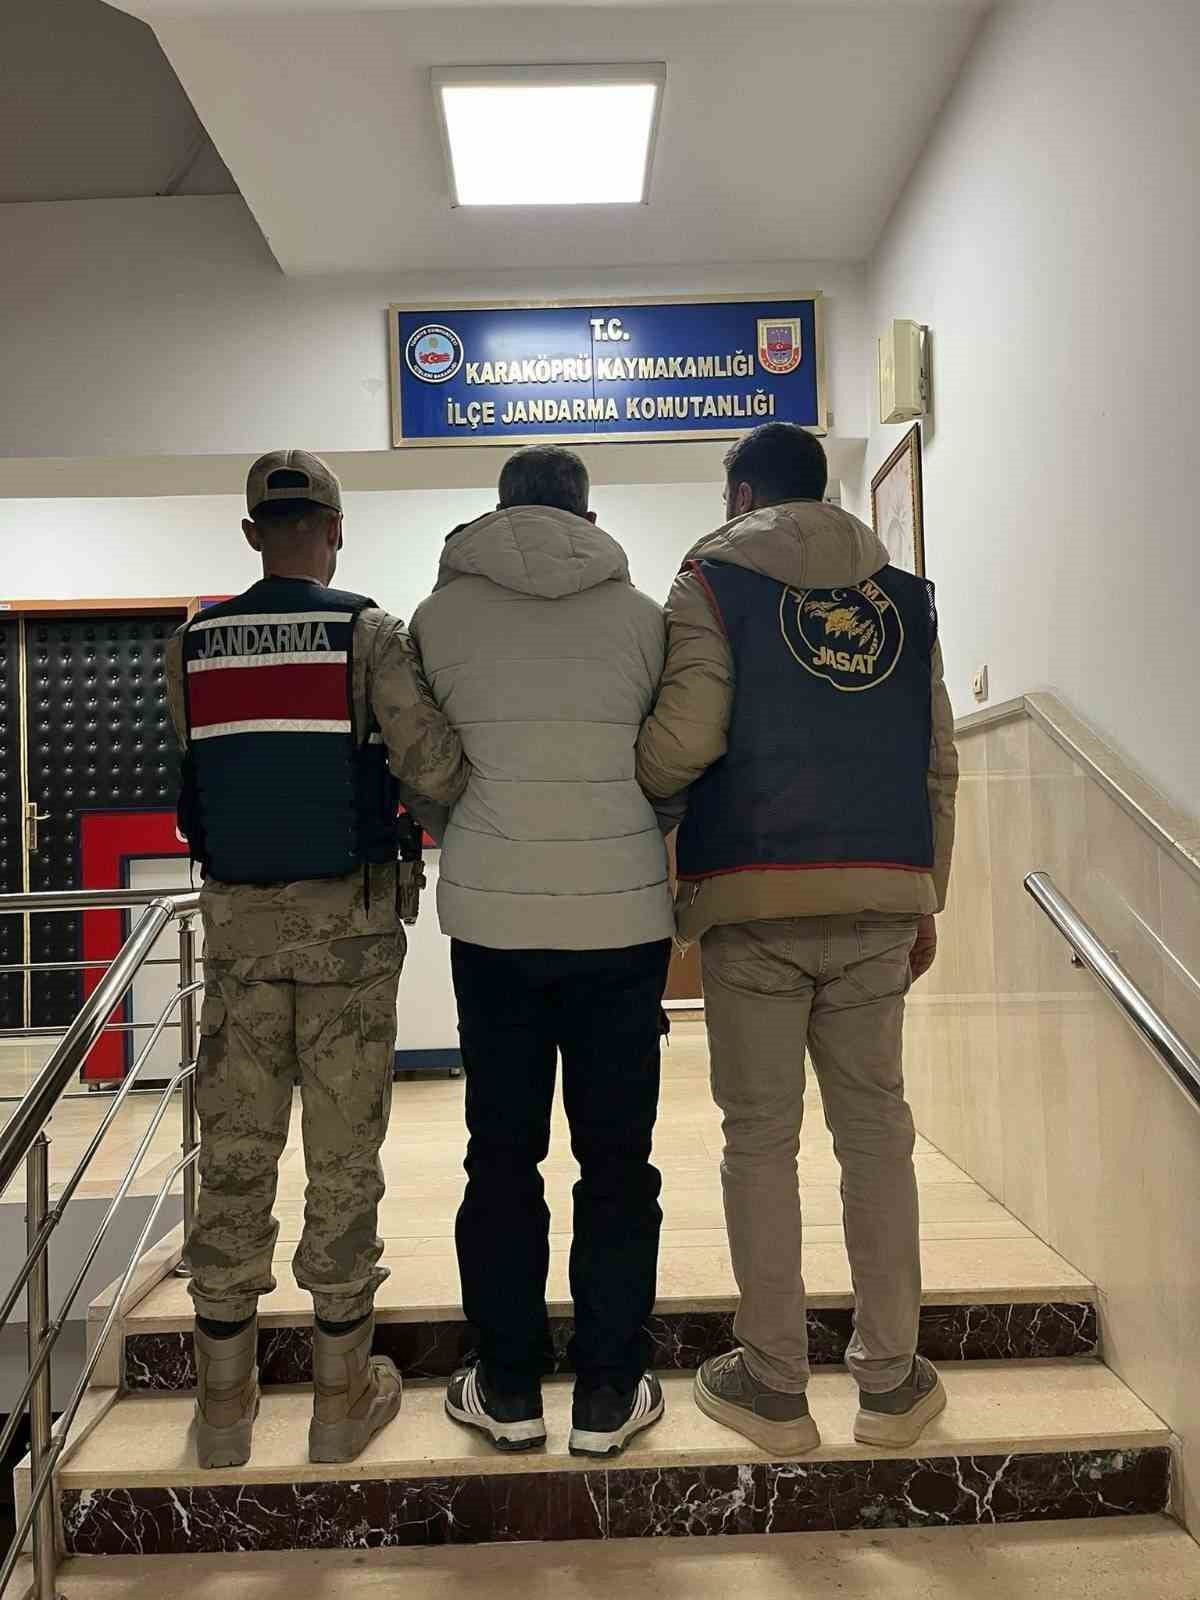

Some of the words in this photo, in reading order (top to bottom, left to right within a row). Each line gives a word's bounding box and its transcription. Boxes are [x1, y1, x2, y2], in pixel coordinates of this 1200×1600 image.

[590, 318, 630, 342] T.C.
[465, 353, 592, 385] KARAKÖPRÜ
[597, 350, 754, 381] KAYMAKAMLIĞI
[447, 397, 495, 430] İLÇE
[501, 398, 619, 425] JANDARMA
[626, 388, 775, 420] KOMUTANLIĞI
[198, 622, 332, 660] JANDARMA
[812, 646, 877, 675] JASAT
